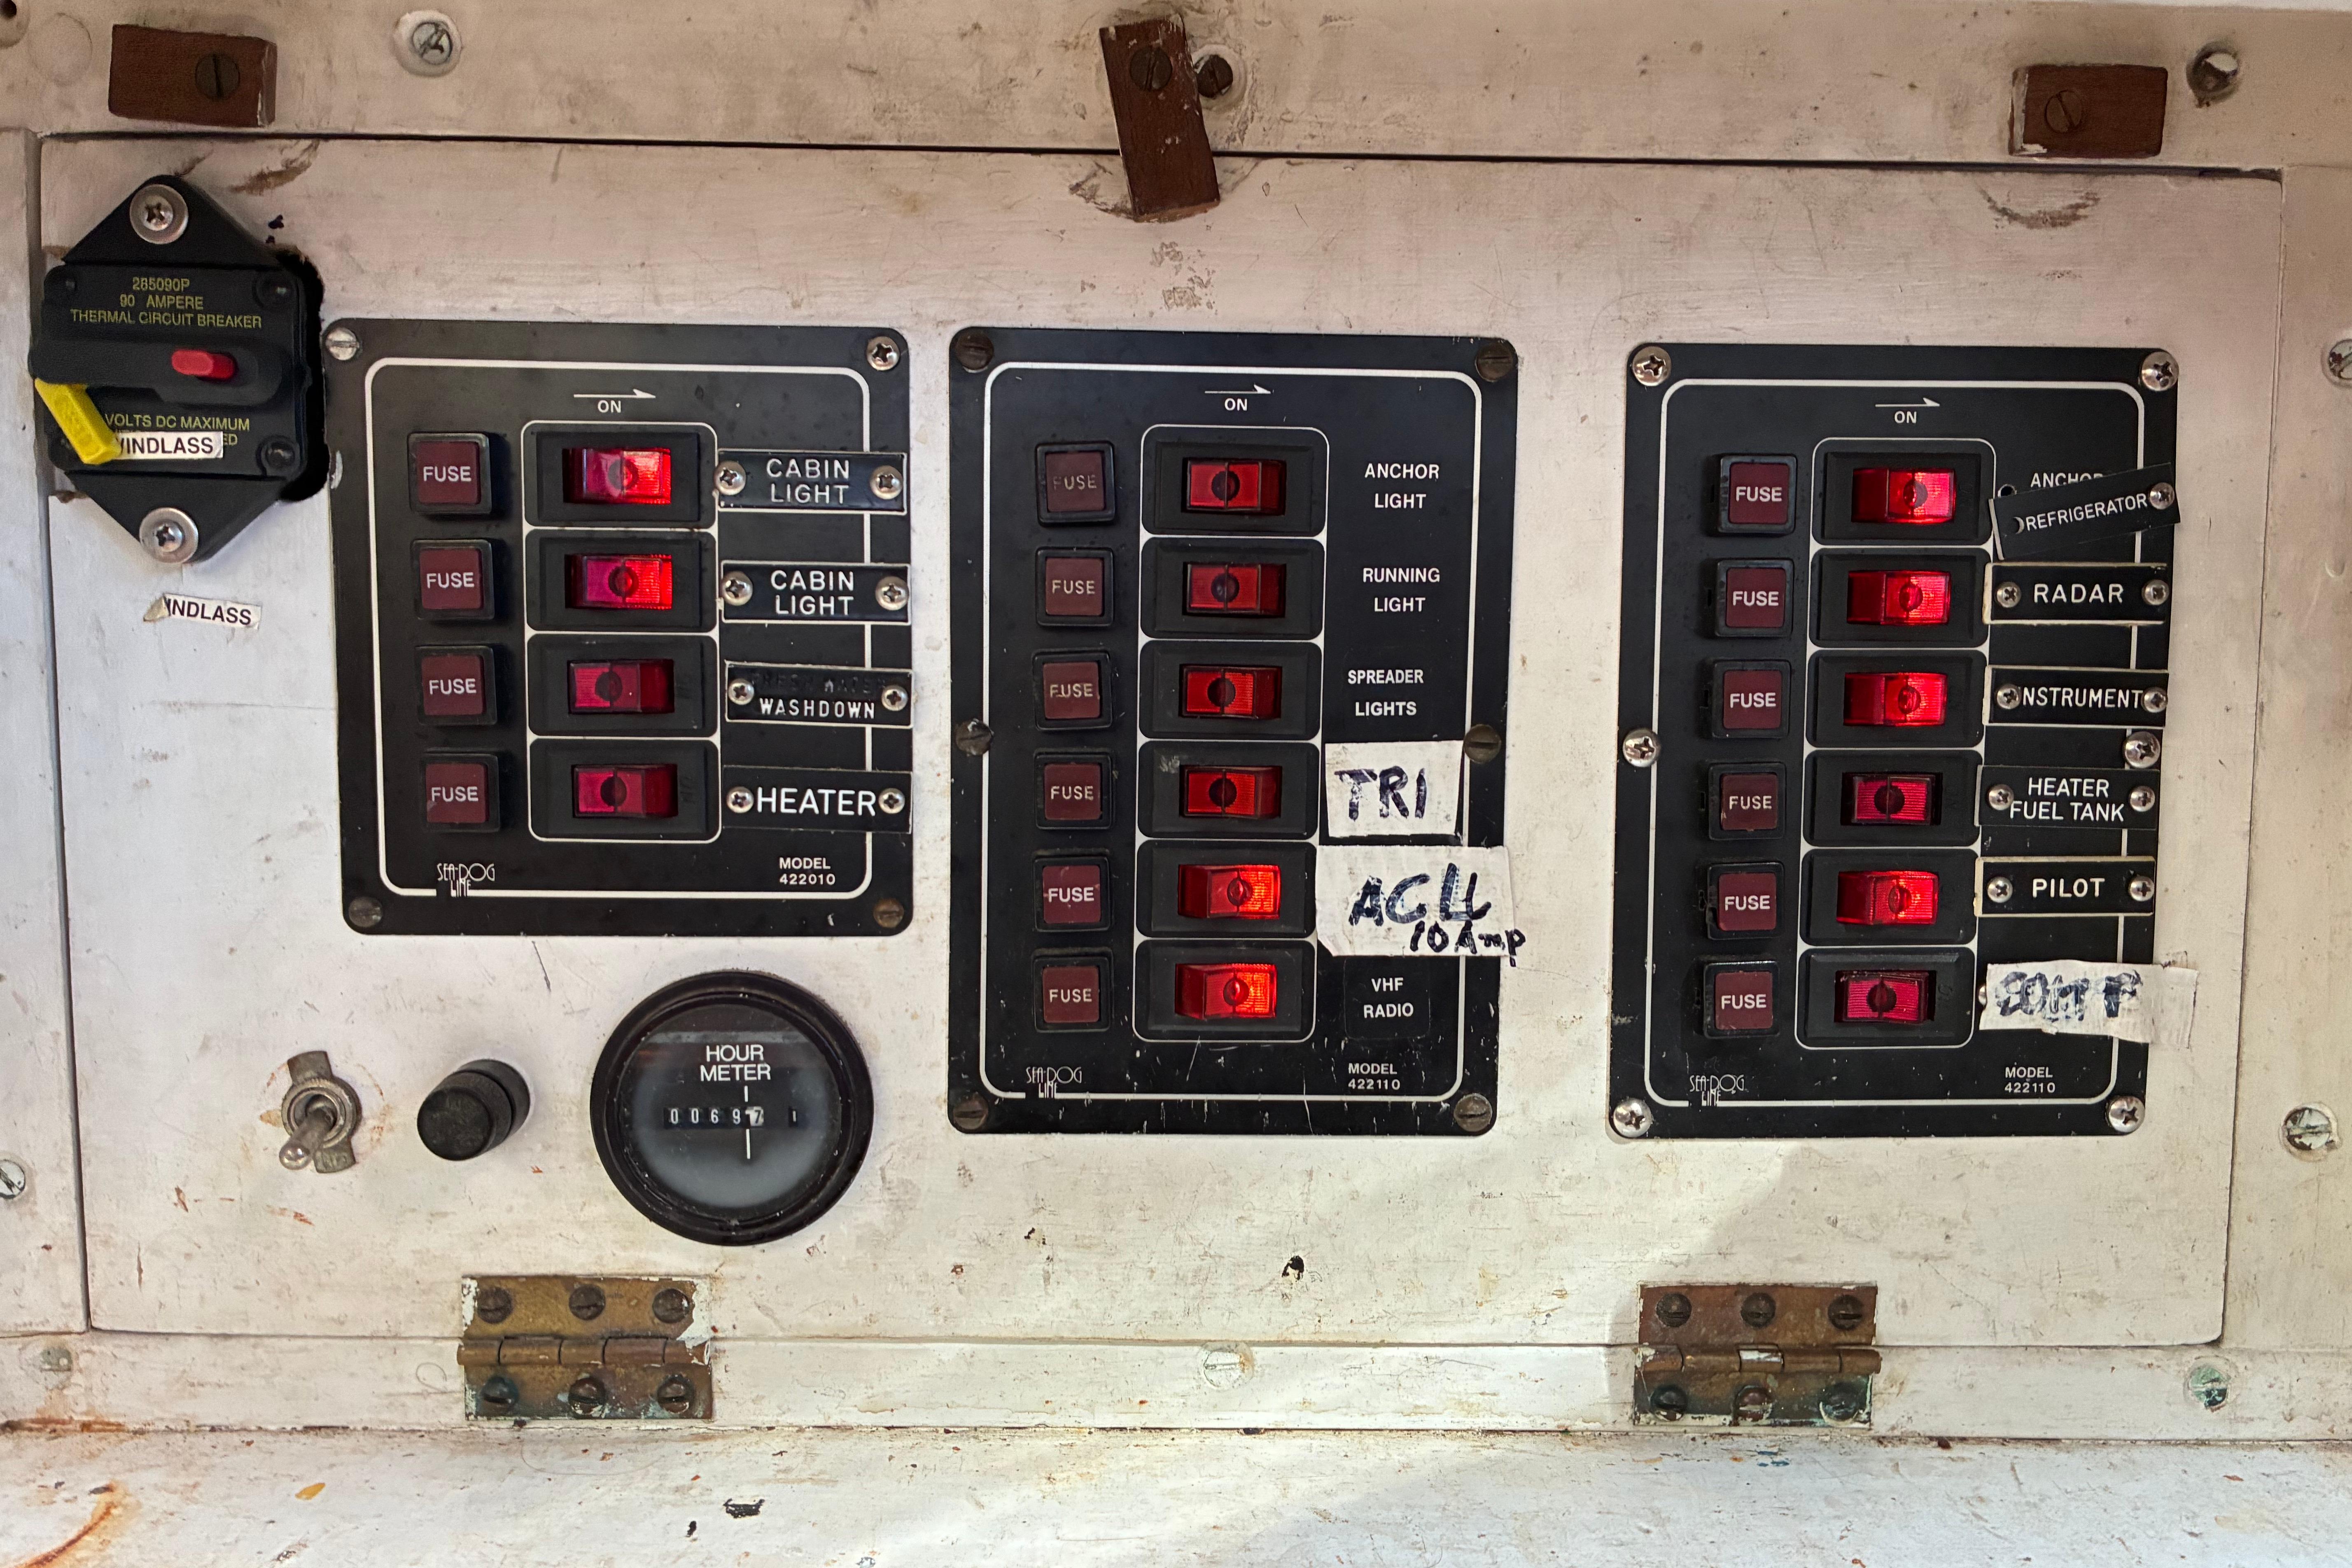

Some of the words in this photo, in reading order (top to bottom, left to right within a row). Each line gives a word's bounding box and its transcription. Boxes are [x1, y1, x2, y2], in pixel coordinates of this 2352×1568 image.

[120, 294, 135, 307] 90
[147, 294, 203, 310] AMPERE
[70, 309, 135, 324] THERMAL
[139, 312, 194, 325] CIRCUIT
[198, 314, 261, 328] BREAKER
[598, 400, 621, 413] ON
[1225, 398, 1247, 411] ON
[105, 413, 152, 427] VOLTS
[156, 415, 176, 428] DC
[181, 416, 249, 431] MAXIMUM
[1895, 411, 1916, 423] ON
[117, 436, 215, 454] INDLASS
[423, 466, 471, 482] FUSE
[767, 459, 849, 480] CABIN
[1365, 463, 1439, 479] ANCHOR
[1052, 474, 1098, 491] FUSE
[2030, 472, 2103, 489] ANCH
[771, 484, 849, 504] LIGHT
[1375, 494, 1426, 508] LIGHT
[1736, 487, 1782, 502] FUSE
[2025, 492, 2148, 532] REFRIGERATOR
[427, 572, 474, 588] FUSE
[771, 570, 853, 591] CABIN
[1363, 568, 1440, 582] RUNNING
[1052, 580, 1095, 594] FUSE
[2034, 584, 2123, 603] RADAR
[776, 595, 854, 616] LIGHT
[1374, 597, 1426, 611] LIGHT
[1733, 591, 1778, 606] FUSE
[166, 597, 252, 625] INDLASS
[1348, 670, 1423, 684] SPREADER
[429, 679, 476, 695] FUSE
[1050, 684, 1093, 698] FUSE
[1730, 693, 1776, 708] FUSE
[2017, 685, 2144, 710] NSTRUMENT
[760, 698, 874, 719] WASHDOWN
[1356, 702, 1416, 716] LIGHTS
[432, 786, 478, 802] FUSE
[1051, 786, 1093, 800] FUSE
[1334, 765, 1428, 821] TRI
[2028, 777, 2109, 797] HEATER
[758, 787, 875, 816] HEATER
[1729, 796, 1772, 810] FUSE
[2009, 801, 2064, 820] FUEL
[2070, 803, 2124, 821] TANK
[779, 857, 831, 869] MODEL
[780, 874, 835, 885] 422010
[2033, 878, 2105, 897] PILOT
[1048, 887, 1094, 902] FUSE
[1725, 896, 1770, 910] FUSE
[1410, 921, 1449, 953] 10
[1372, 978, 1403, 992] VHF
[1050, 989, 1092, 1003] FUSE
[1722, 994, 1766, 1009] FUSE
[1364, 1003, 1413, 1018] RADIO
[707, 1044, 763, 1062] HOUR
[700, 1063, 770, 1081] METER
[1349, 1063, 1397, 1074] MODEL
[2005, 1067, 2053, 1078] MODEL
[1349, 1078, 1400, 1090] 422110
[2005, 1083, 2055, 1093] 422110
